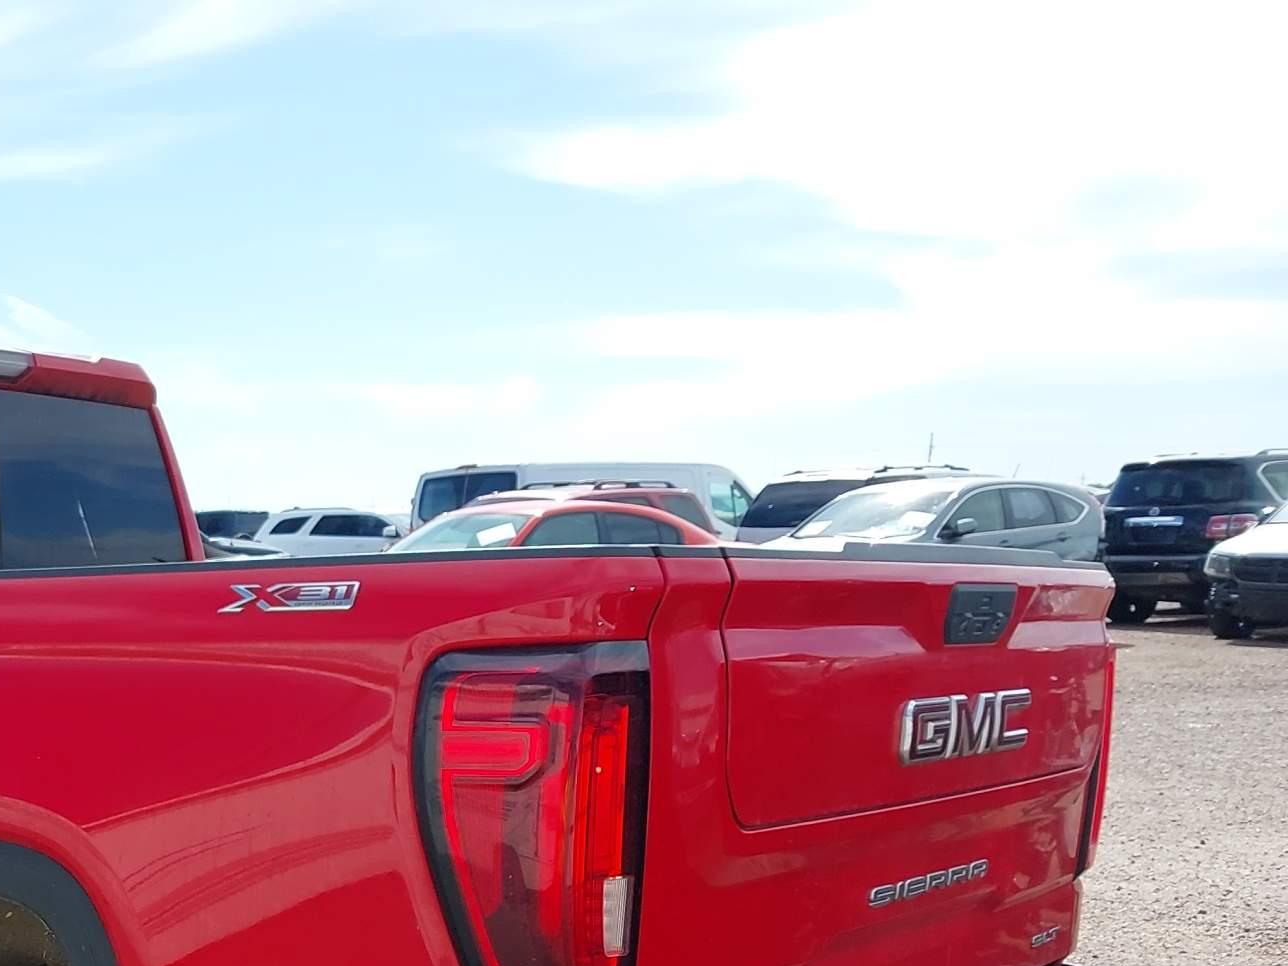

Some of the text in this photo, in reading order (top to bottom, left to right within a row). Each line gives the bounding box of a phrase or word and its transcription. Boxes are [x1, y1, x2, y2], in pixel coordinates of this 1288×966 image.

[899, 688, 1032, 766] GMC
[869, 858, 989, 907] SIERRA
[1031, 926, 1061, 948] SLT
